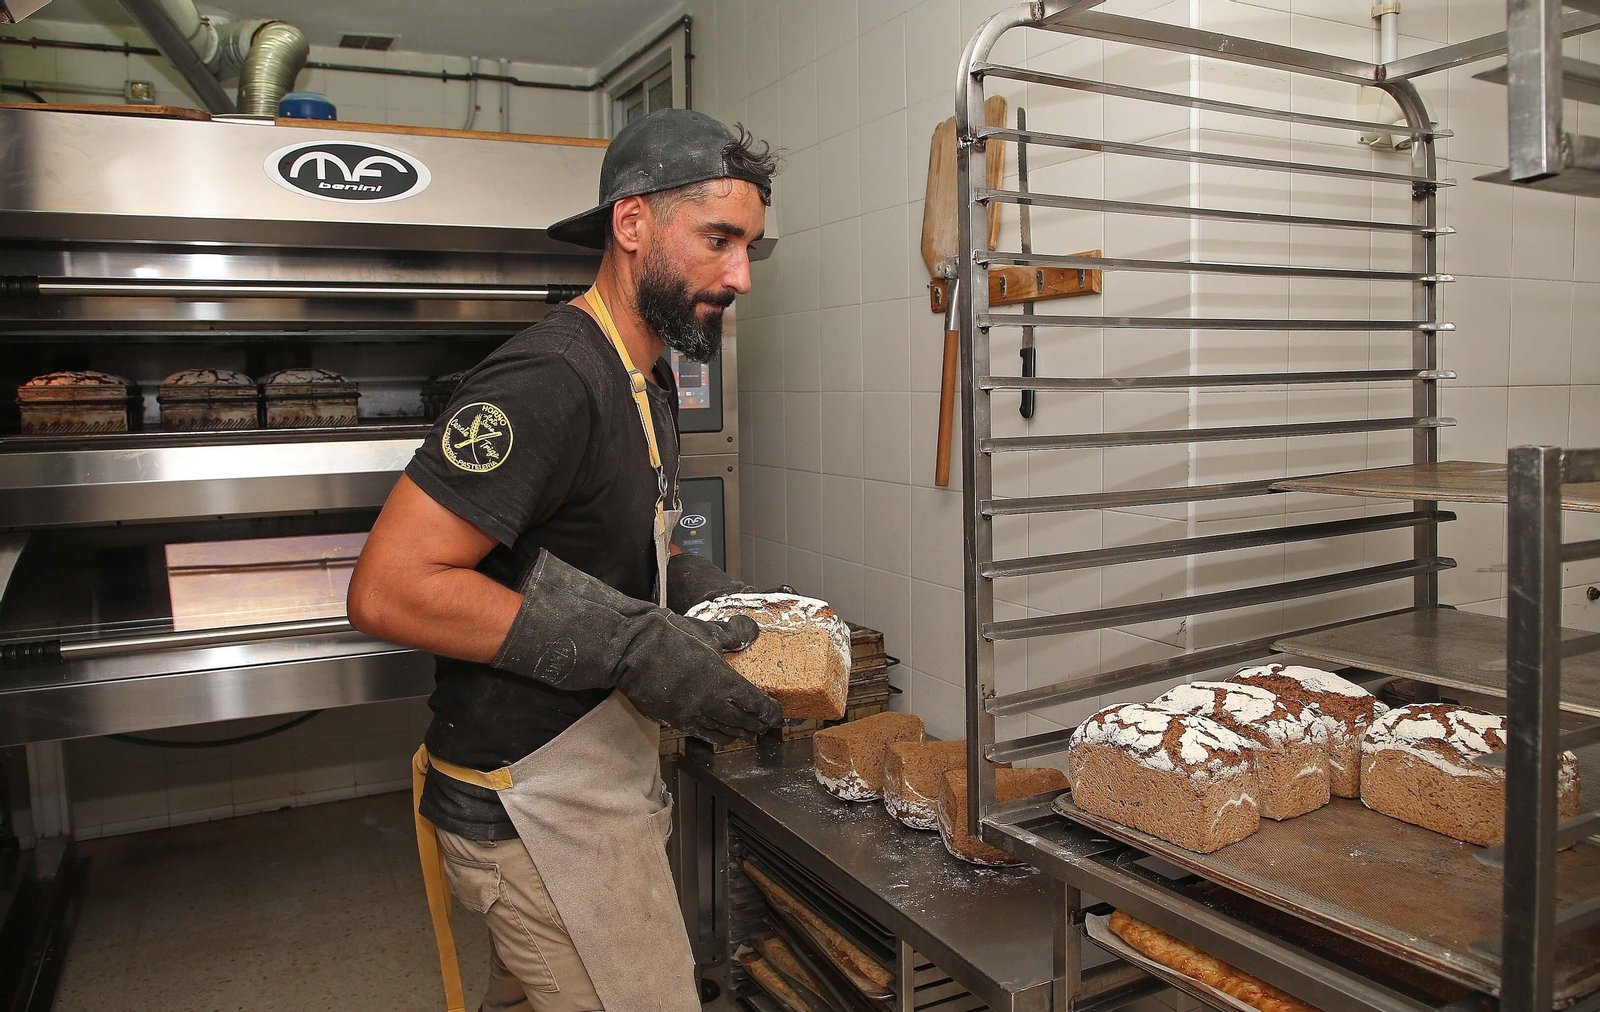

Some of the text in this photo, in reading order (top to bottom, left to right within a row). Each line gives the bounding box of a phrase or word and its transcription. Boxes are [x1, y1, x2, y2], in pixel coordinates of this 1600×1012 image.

[318, 182, 383, 192] benini
[481, 405, 507, 426] HORNO
[480, 439, 500, 459] Trigo
